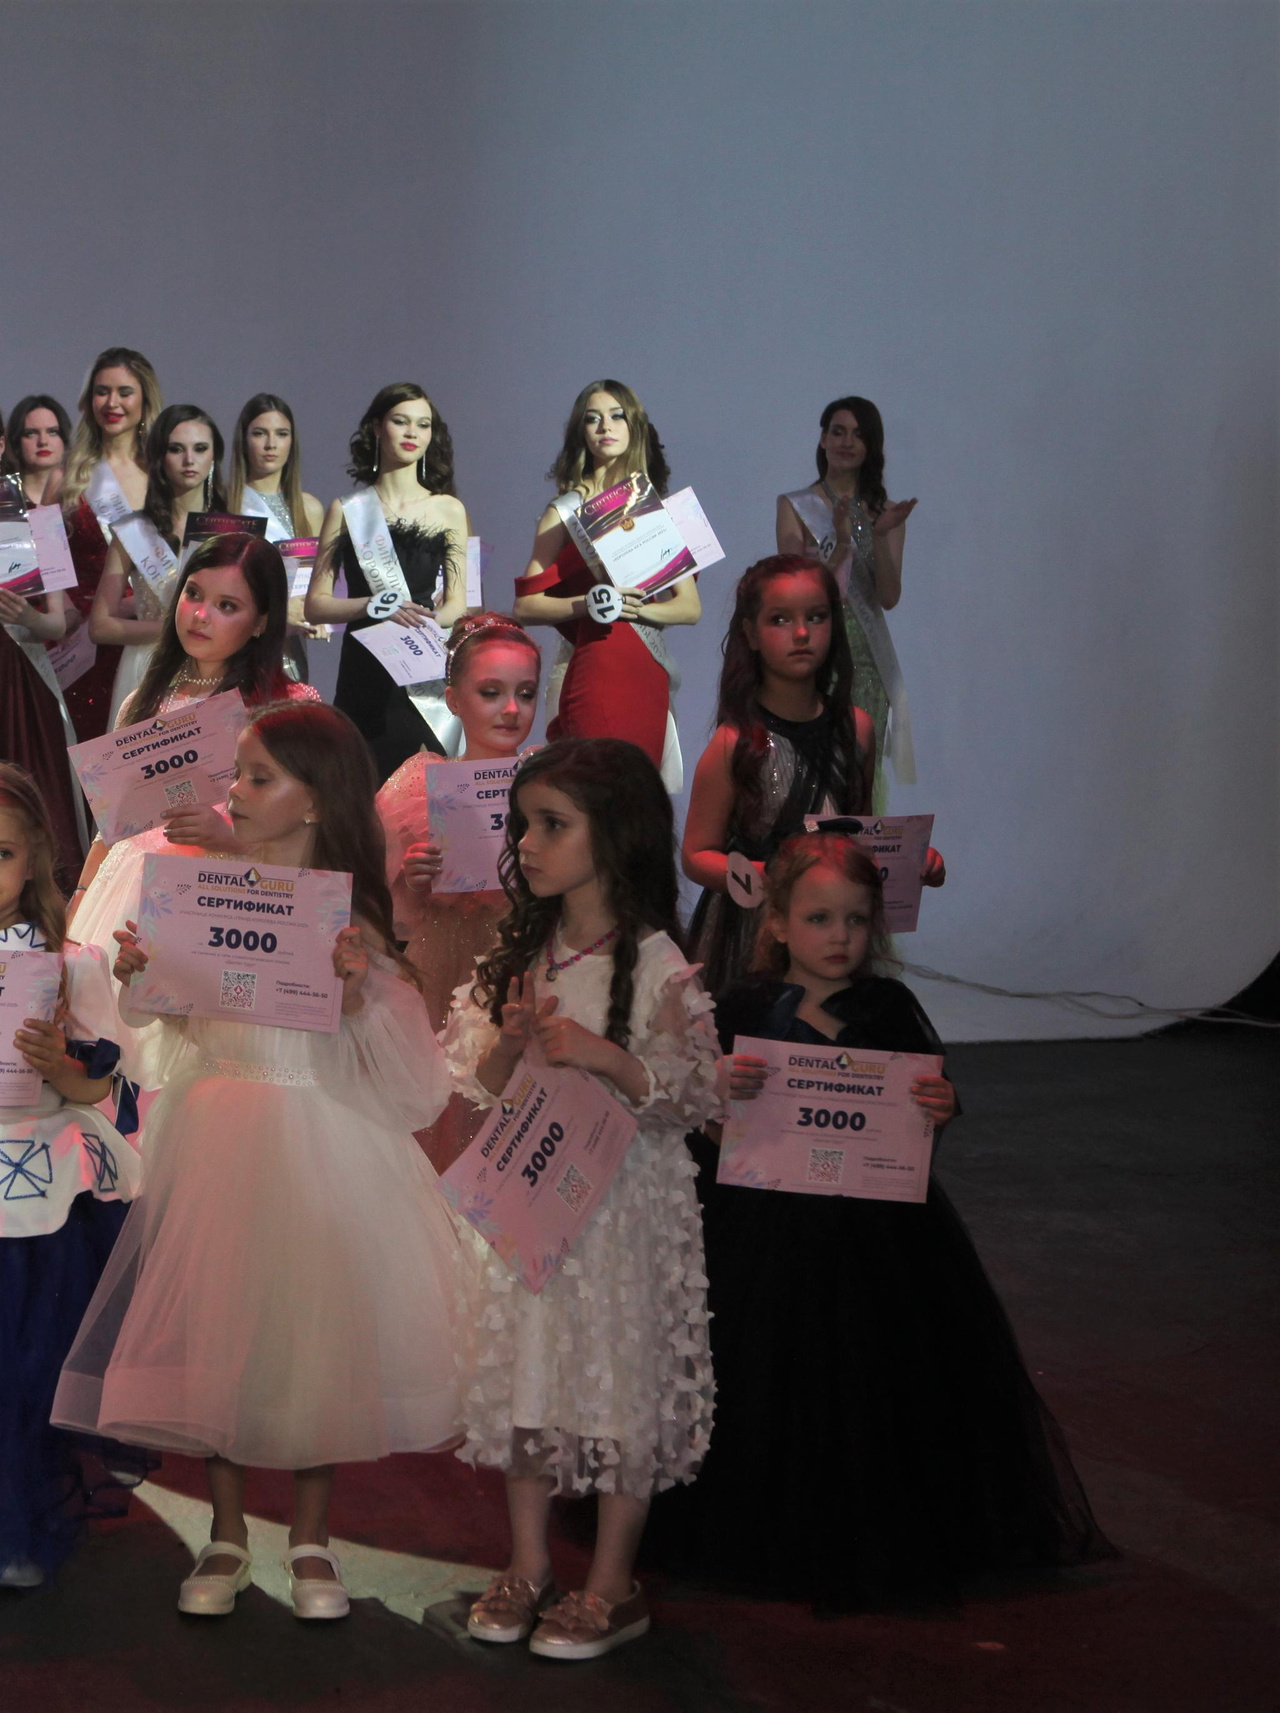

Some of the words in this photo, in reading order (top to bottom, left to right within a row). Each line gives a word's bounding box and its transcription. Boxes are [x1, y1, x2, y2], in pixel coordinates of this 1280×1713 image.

[584, 481, 632, 515] CERTIFICAT
[374, 592, 398, 615] 16
[592, 588, 615, 619] 15
[400, 635, 423, 656] 3000
[115, 727, 156, 747] DENTAL
[166, 713, 196, 728] GURU
[121, 725, 203, 760] СЕРТИФИКАТ
[138, 748, 200, 780] 3000
[474, 769, 515, 781] DENTAL
[198, 872, 245, 887] DENTAL
[197, 895, 294, 915] СЕРТИФИКАТ
[208, 926, 276, 953] 3000
[788, 1056, 836, 1070] DENTAL
[787, 1078, 884, 1096] СЕРТИФИКАТ
[495, 1086, 549, 1173] СЕРТИФИКАТ
[797, 1106, 865, 1131] 3000
[480, 1112, 510, 1159] DENTAL
[519, 1119, 566, 1188] 3000
